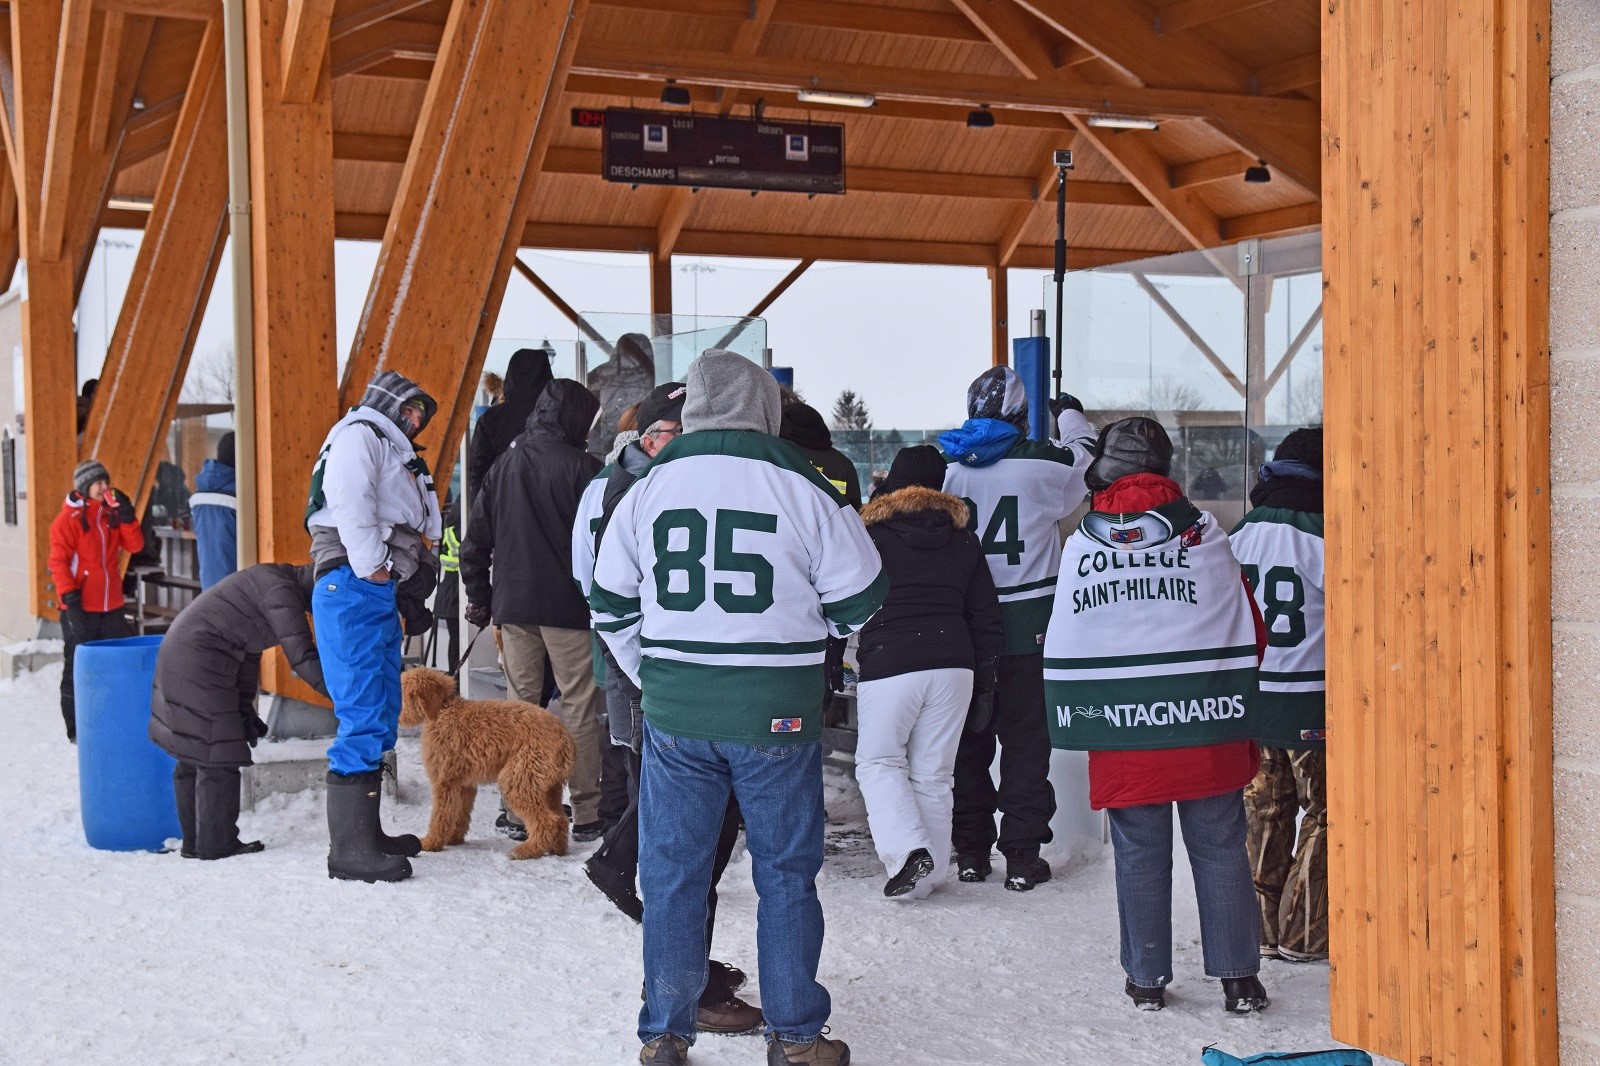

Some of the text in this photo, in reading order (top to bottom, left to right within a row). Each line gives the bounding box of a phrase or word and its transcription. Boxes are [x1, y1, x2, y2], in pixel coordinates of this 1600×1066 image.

[610, 164, 675, 180] DESCHAMPS
[652, 508, 778, 614] 85
[1072, 577, 1198, 615] SAINT-HILAIRE
